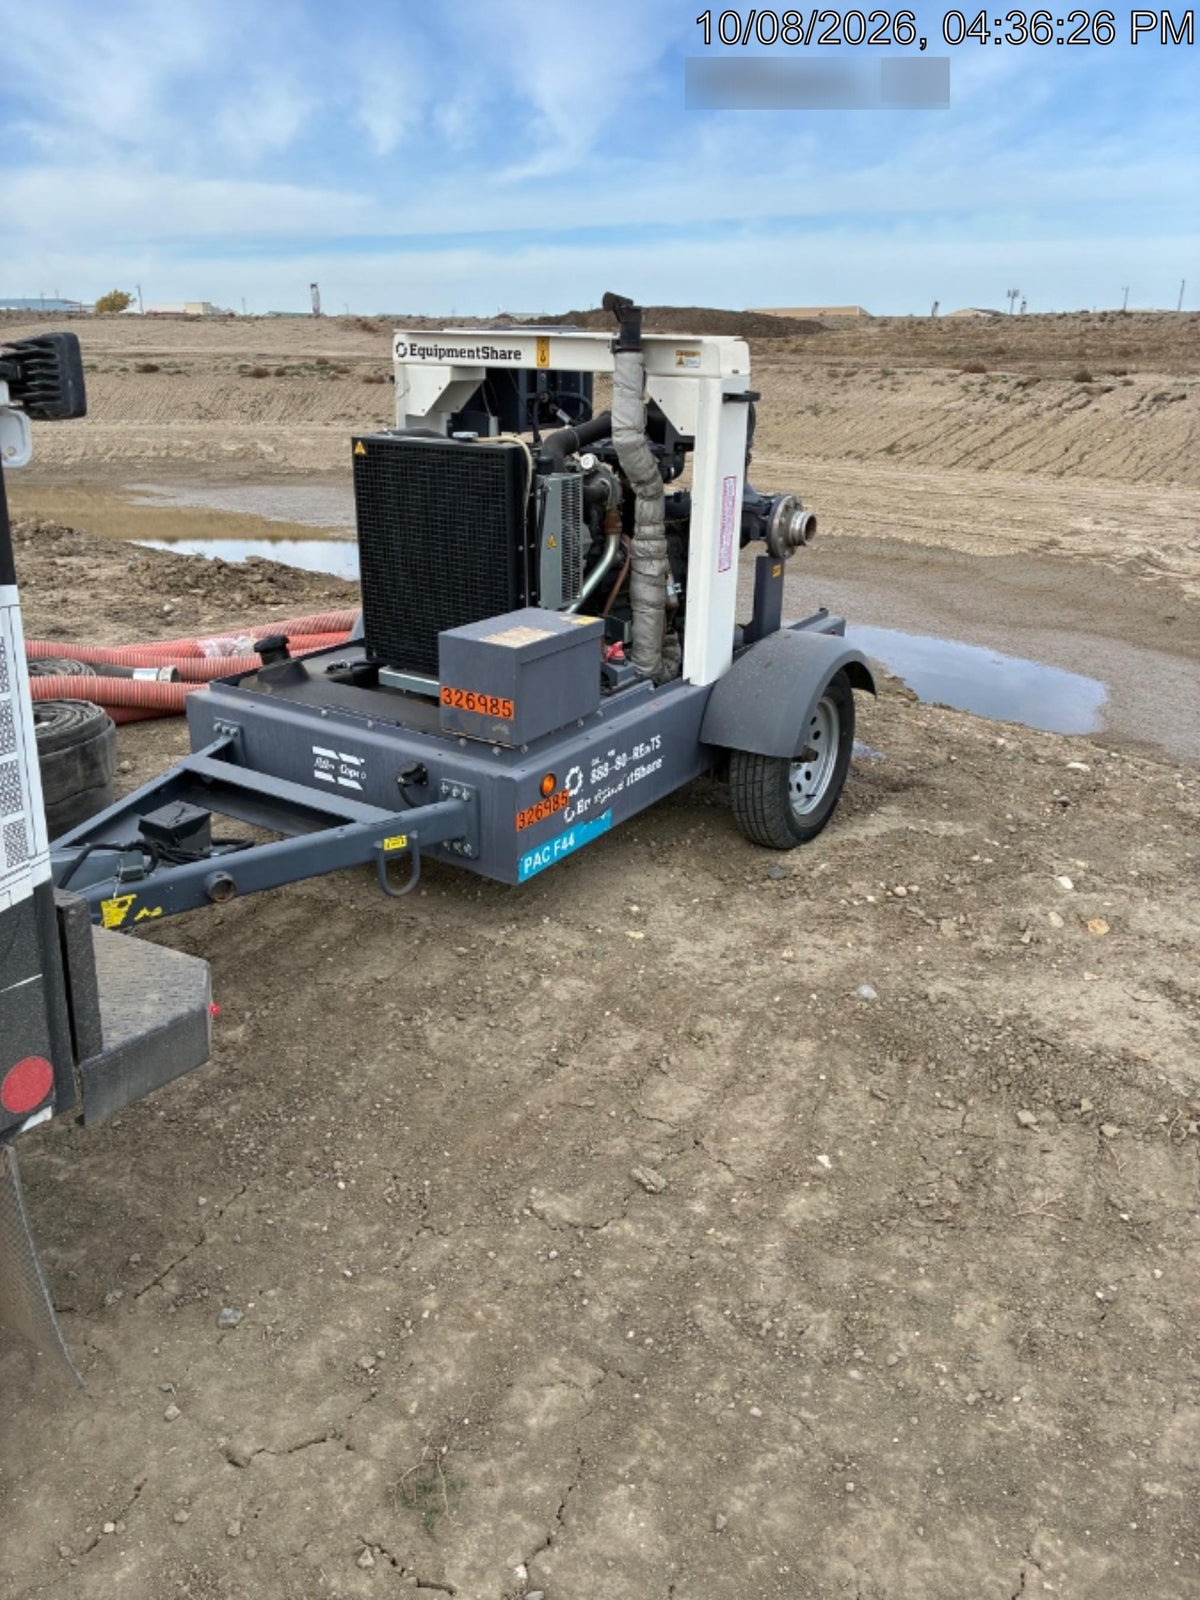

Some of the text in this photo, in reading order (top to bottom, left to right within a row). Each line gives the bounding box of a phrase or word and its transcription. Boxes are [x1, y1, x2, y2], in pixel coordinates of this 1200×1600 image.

[409, 343, 522, 361] EquipmentShare
[442, 687, 513, 718] 326985
[518, 789, 569, 830] 326985
[523, 832, 575, 874] PAC F44
